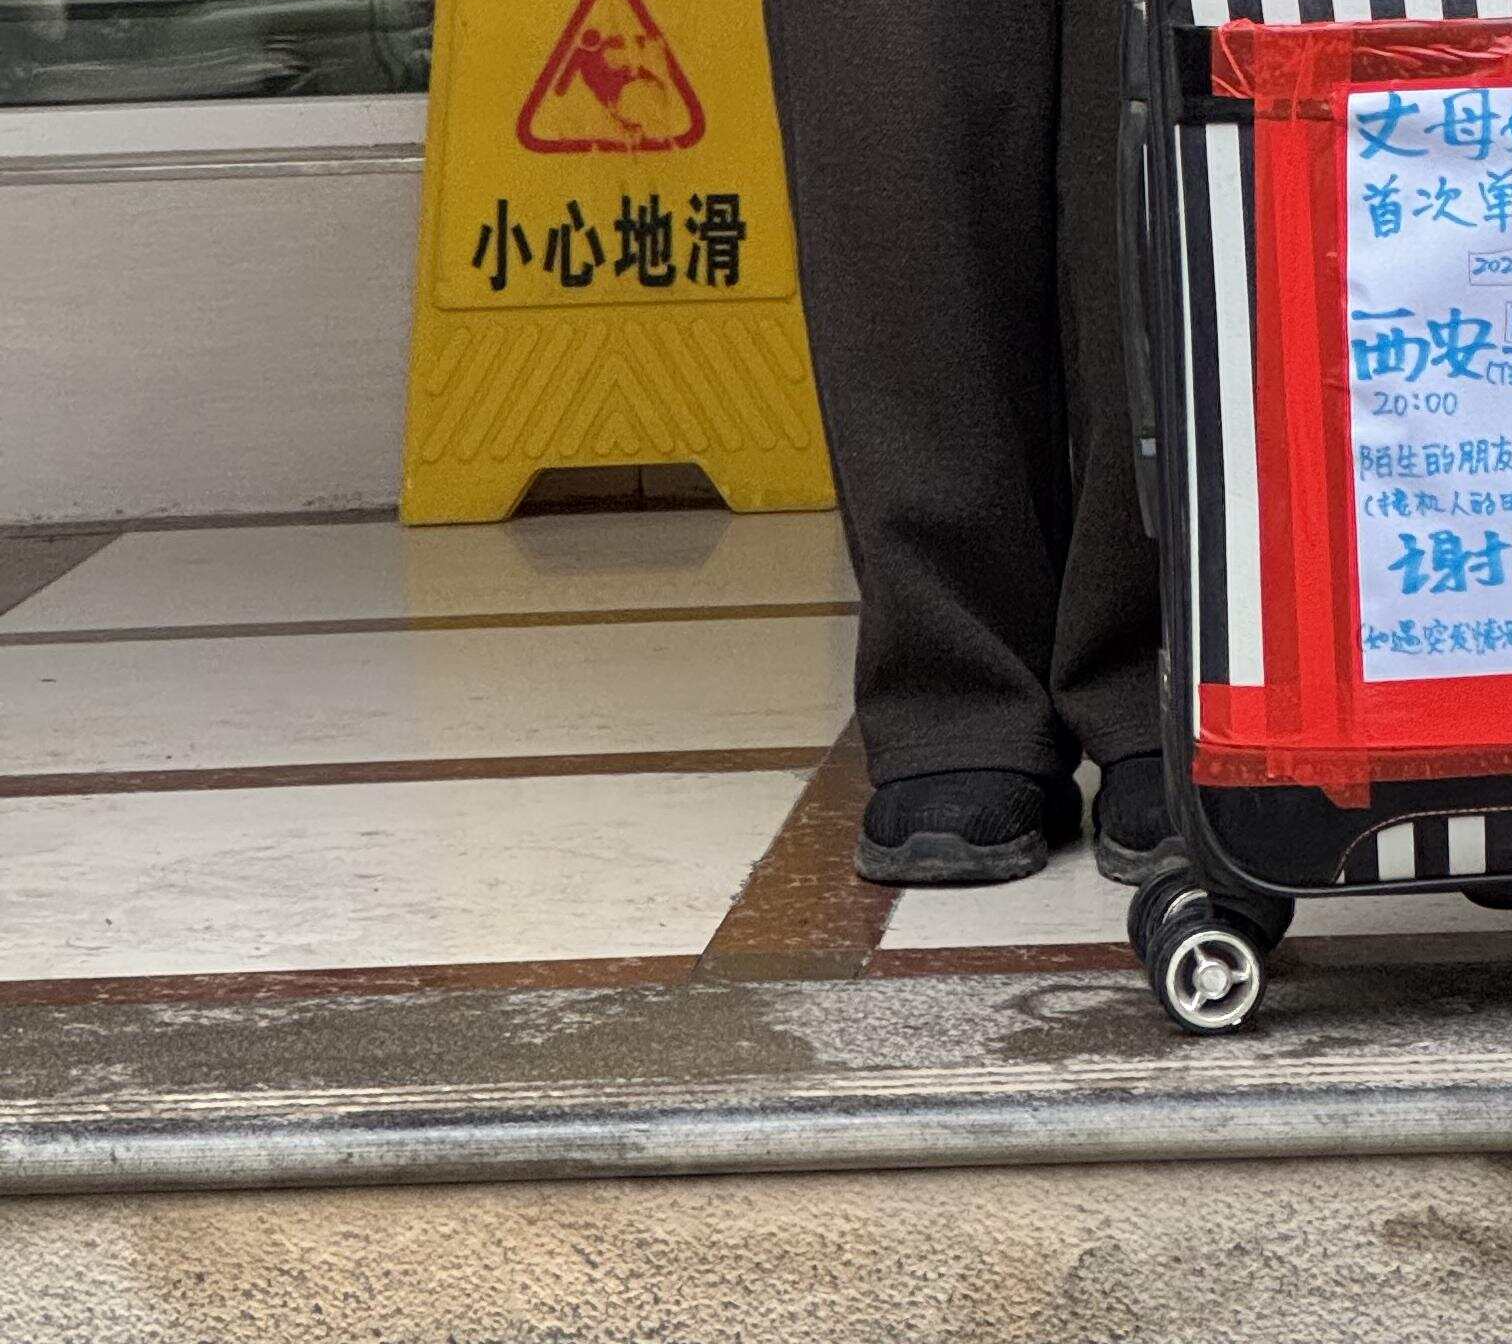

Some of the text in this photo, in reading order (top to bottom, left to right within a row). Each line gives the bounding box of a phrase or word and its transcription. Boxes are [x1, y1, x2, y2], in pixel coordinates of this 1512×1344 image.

[472, 193, 747, 292] 小心地滑
[1351, 307, 1498, 383] 西安
[1371, 390, 1459, 416] 20:00
